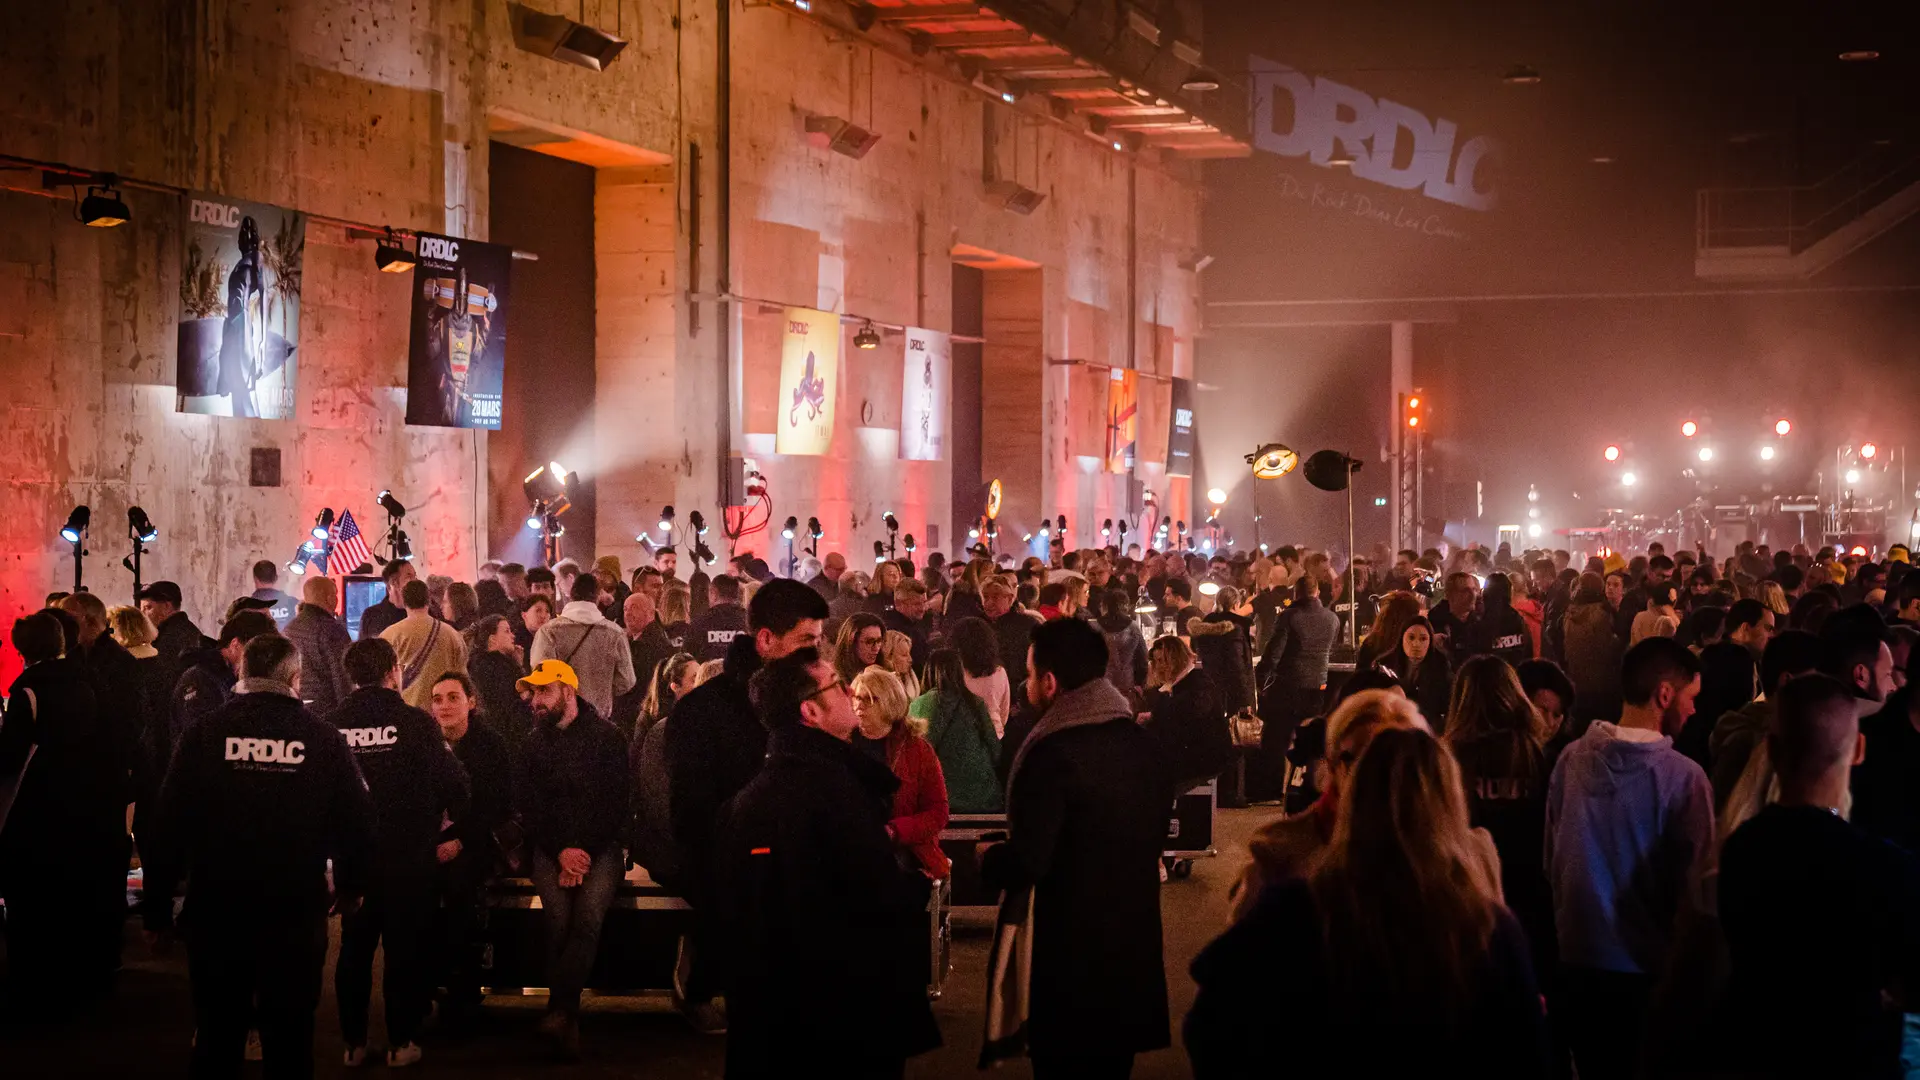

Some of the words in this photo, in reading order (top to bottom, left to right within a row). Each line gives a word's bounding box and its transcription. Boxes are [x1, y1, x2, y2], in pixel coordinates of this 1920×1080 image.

[1250, 54, 1498, 210] DRDLC
[190, 199, 240, 228] DRDLC
[420, 236, 459, 262] DRDLC
[481, 401, 501, 417] MARS
[1335, 602, 1359, 612] DRDC
[707, 630, 746, 643] DRD
[225, 737, 305, 764] DRDLC
